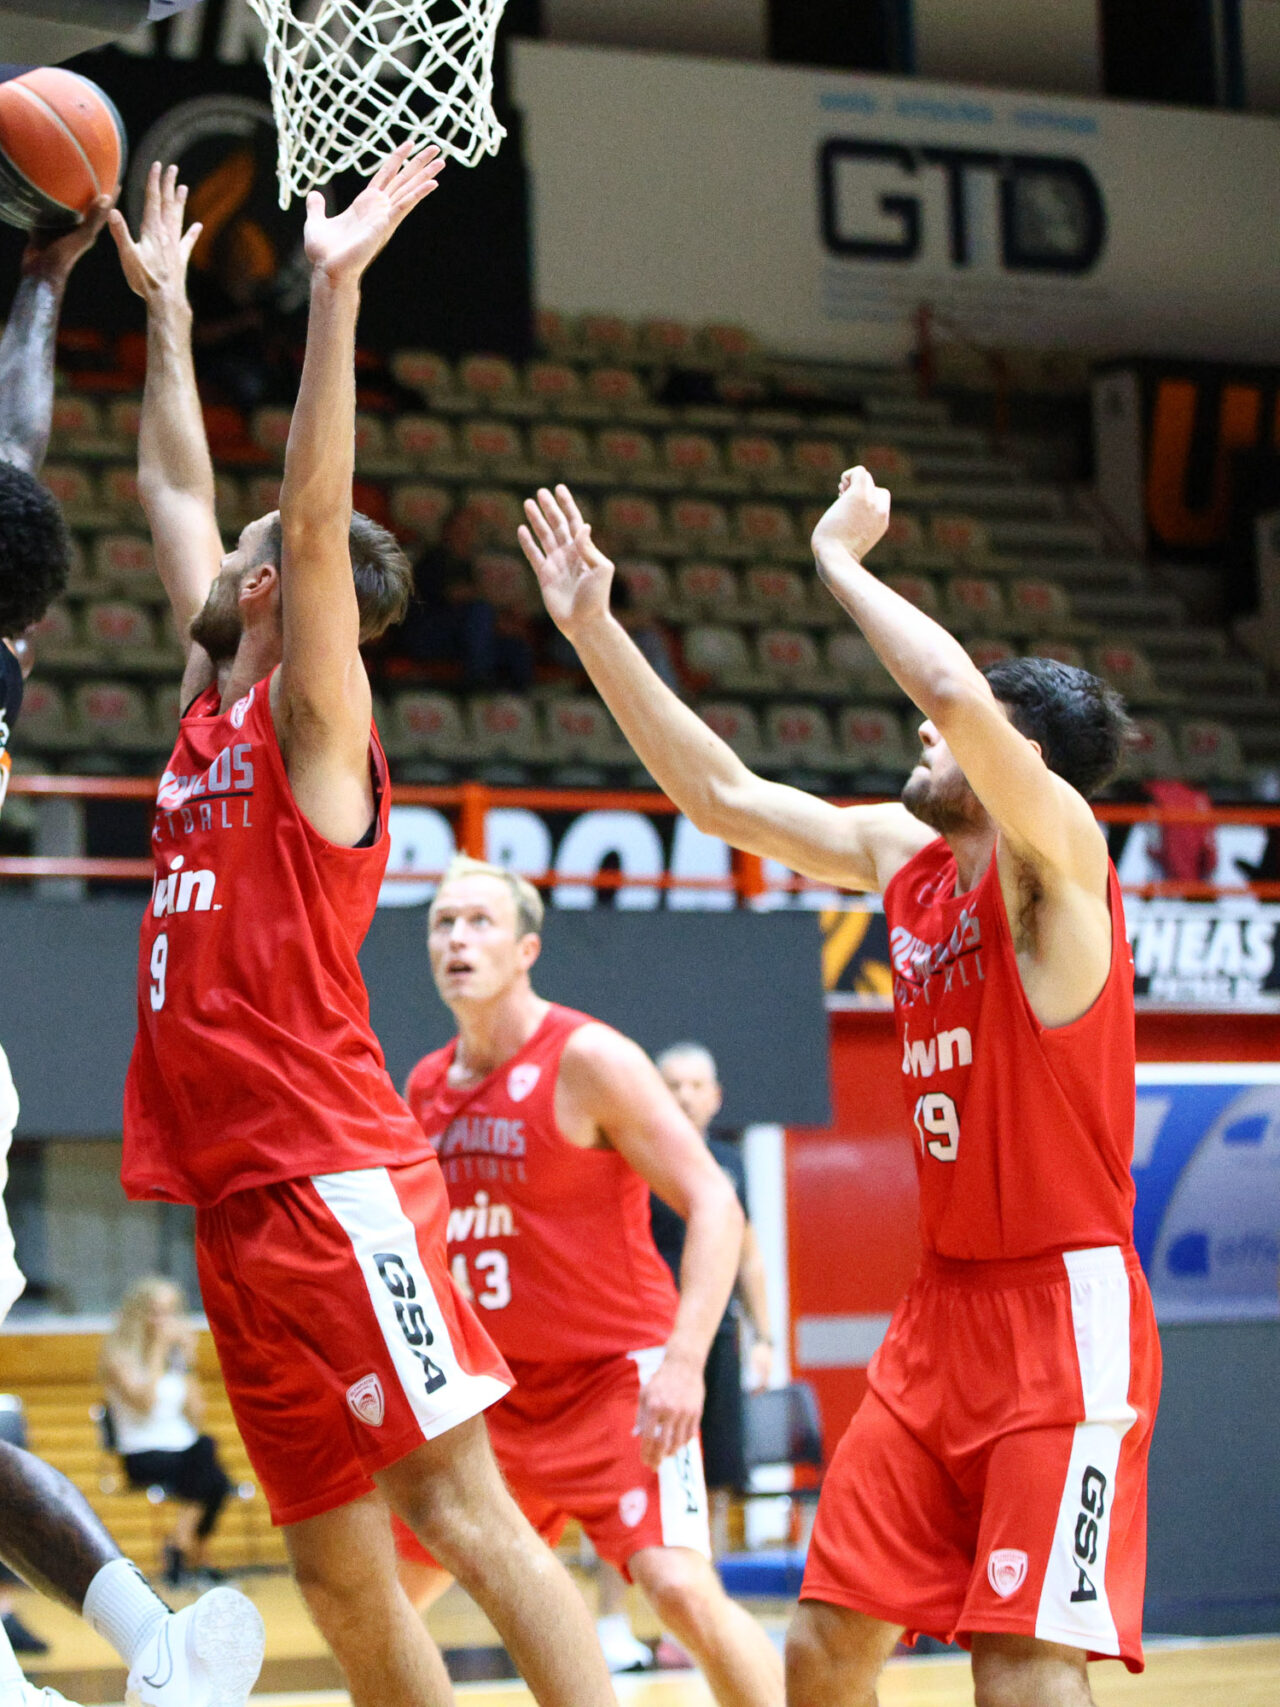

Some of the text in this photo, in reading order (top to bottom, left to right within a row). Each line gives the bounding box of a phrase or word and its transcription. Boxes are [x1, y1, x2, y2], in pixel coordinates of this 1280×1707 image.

[149, 932, 169, 1012] 9
[914, 1091, 961, 1163] 9
[373, 1252, 448, 1395] GSA
[1070, 1465, 1107, 1603] GSA
